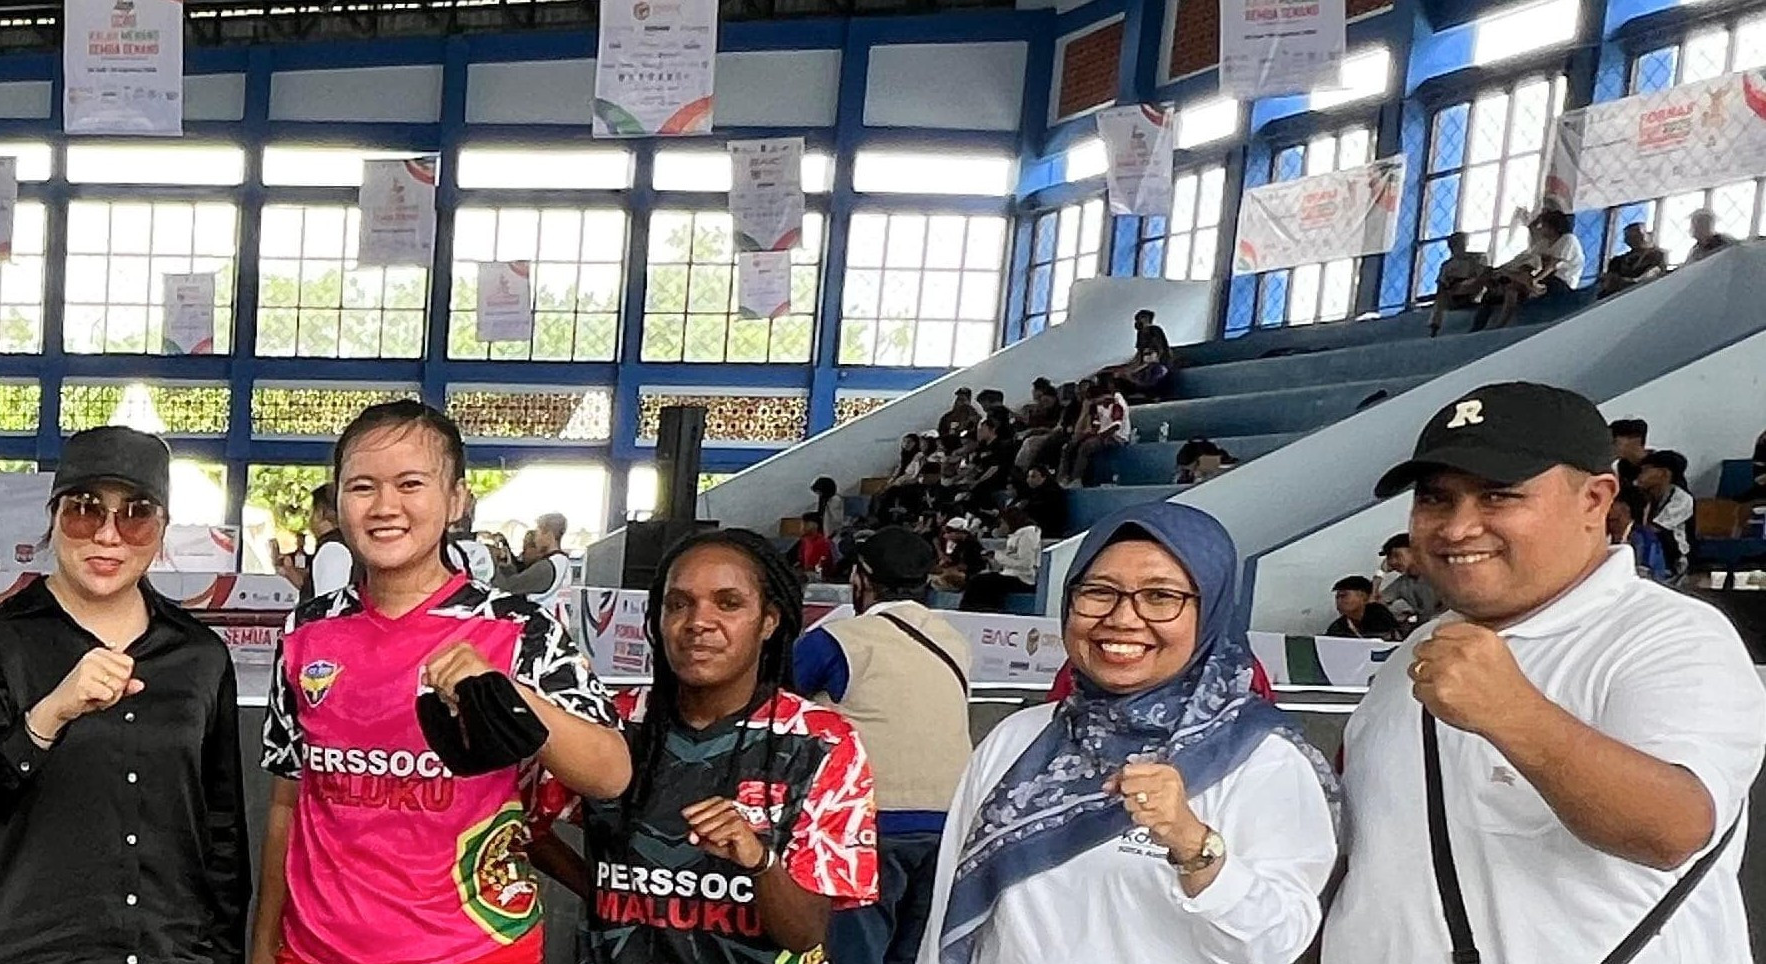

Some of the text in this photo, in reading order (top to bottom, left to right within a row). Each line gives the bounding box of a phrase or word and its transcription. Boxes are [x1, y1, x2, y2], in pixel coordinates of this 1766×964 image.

[1447, 400, 1484, 428] R
[223, 627, 272, 646] SEMUA
[597, 861, 754, 903] PERSSOC
[596, 890, 764, 936] MALUKU
